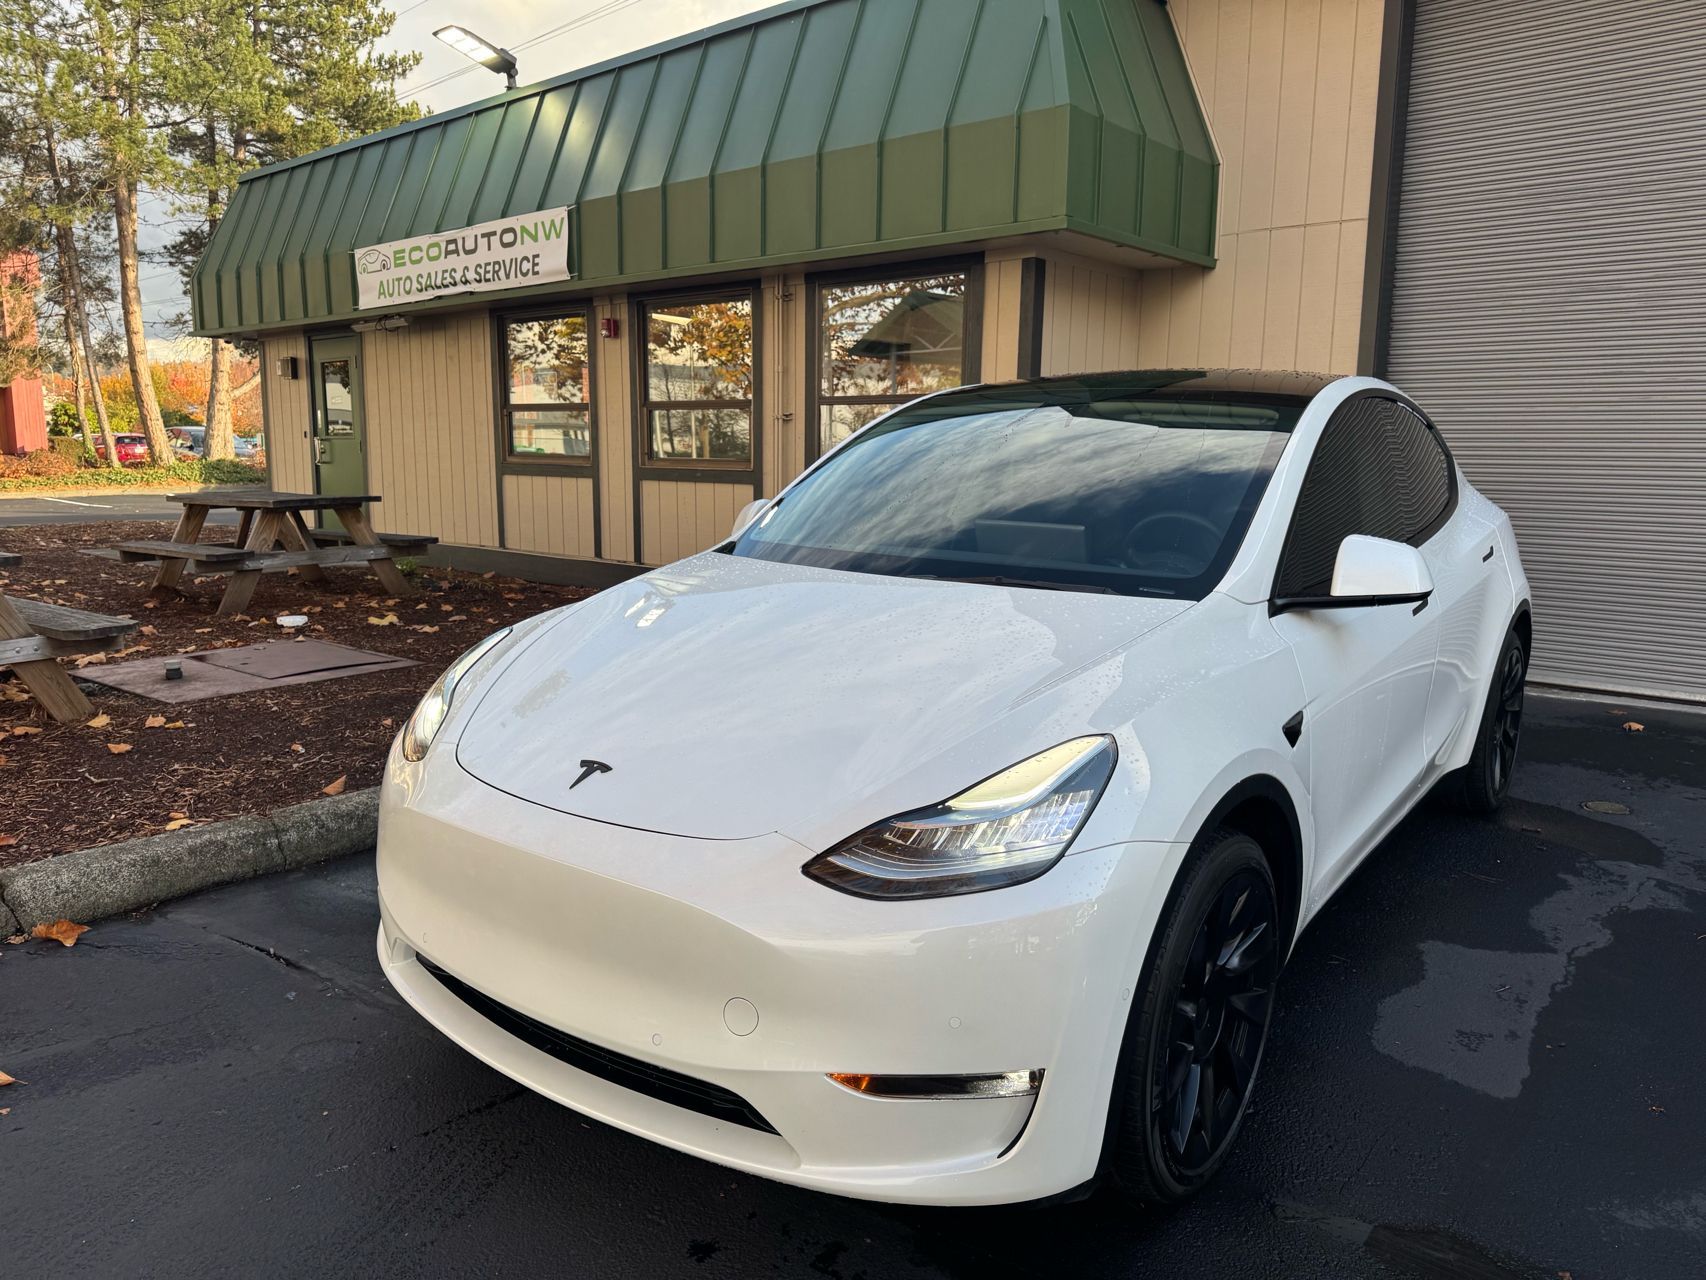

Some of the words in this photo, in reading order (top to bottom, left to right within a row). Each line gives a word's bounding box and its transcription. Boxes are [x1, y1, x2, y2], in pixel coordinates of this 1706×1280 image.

[378, 275, 413, 299] AUTO
[416, 267, 458, 293] SALES
[460, 265, 471, 286] &
[474, 253, 540, 284] SERVICE
